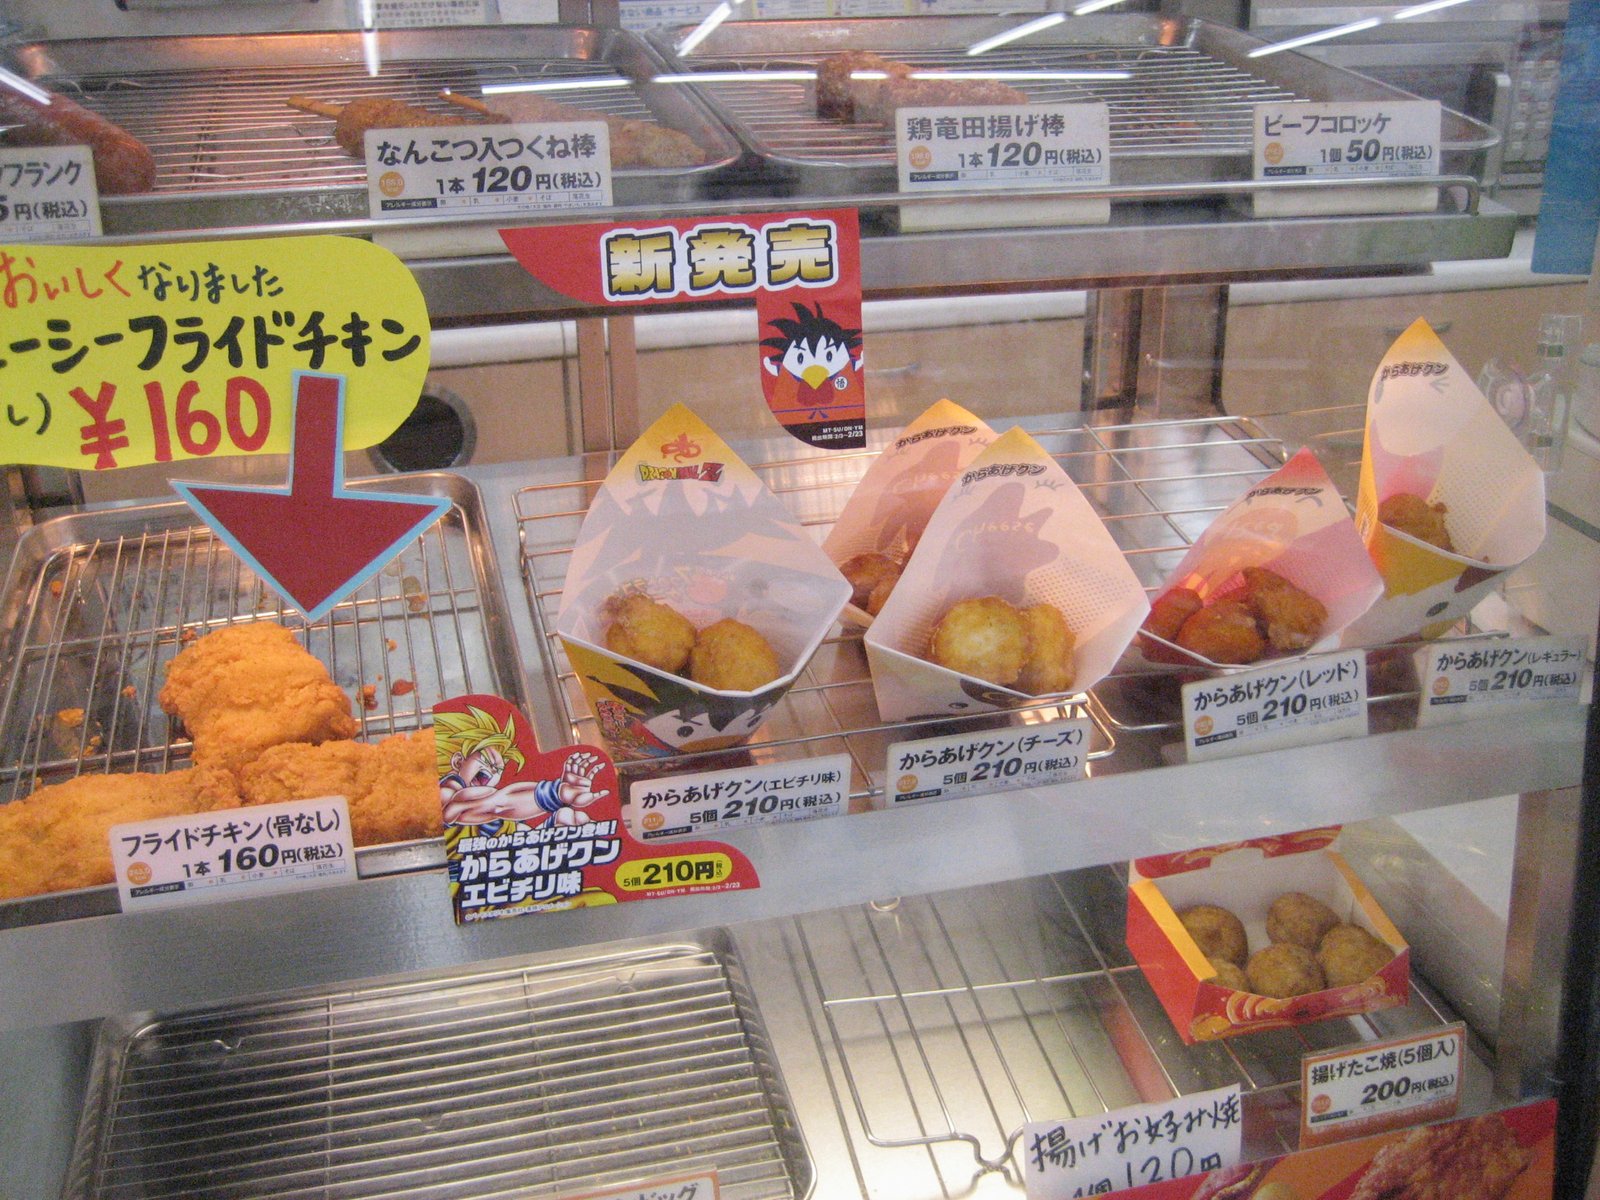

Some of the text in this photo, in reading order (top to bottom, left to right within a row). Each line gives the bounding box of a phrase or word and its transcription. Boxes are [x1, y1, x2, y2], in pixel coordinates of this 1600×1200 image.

[907, 113, 1066, 141] 鶏竜田揚げ棒
[1264, 112, 1392, 137] ビーフコロッケ
[377, 133, 597, 166] なんこつ入つくね棒
[605, 222, 835, 298] 新発売
[1381, 360, 1449, 381] からあげクン
[896, 425, 978, 450] からあげクン
[962, 463, 1047, 487] からあげクン
[1193, 659, 1359, 712] からあげクン(レッド)
[898, 729, 1084, 771] からあげクン(チーズ)
[121, 808, 341, 858] フライドチキン(骨なし)
[459, 838, 622, 882] からあげクン
[461, 871, 583, 909] エビチリ味
[1311, 1038, 1456, 1086] 揚げたこ焼(5個入)
[1029, 1092, 1241, 1173] 揚げお好み焼
